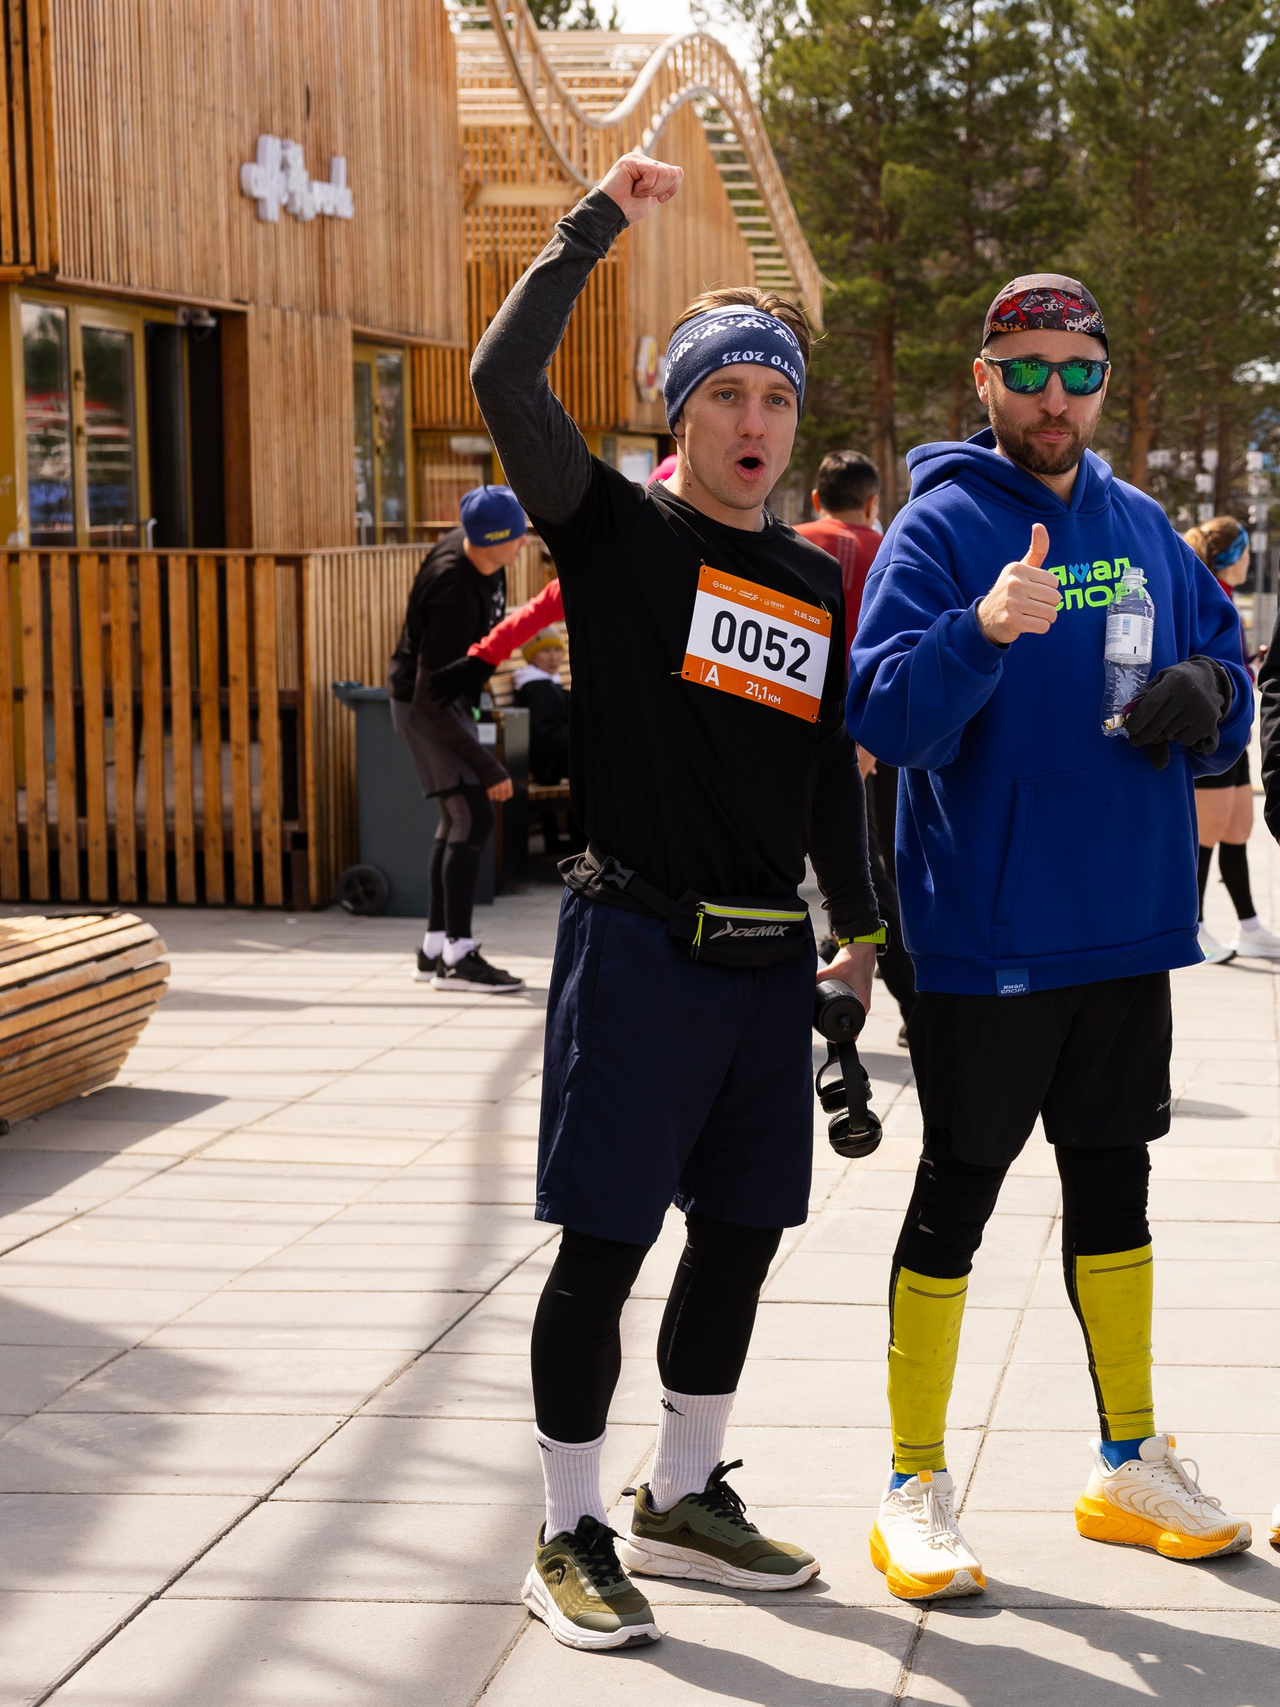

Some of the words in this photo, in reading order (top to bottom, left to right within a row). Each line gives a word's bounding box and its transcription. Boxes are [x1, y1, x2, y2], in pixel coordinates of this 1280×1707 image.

[722, 350, 765, 364] 2023
[1055, 578, 1148, 611] пор
[793, 609, 821, 625] 31.05.2025
[711, 610, 811, 683] 0052
[730, 925, 790, 937] DEMIX
